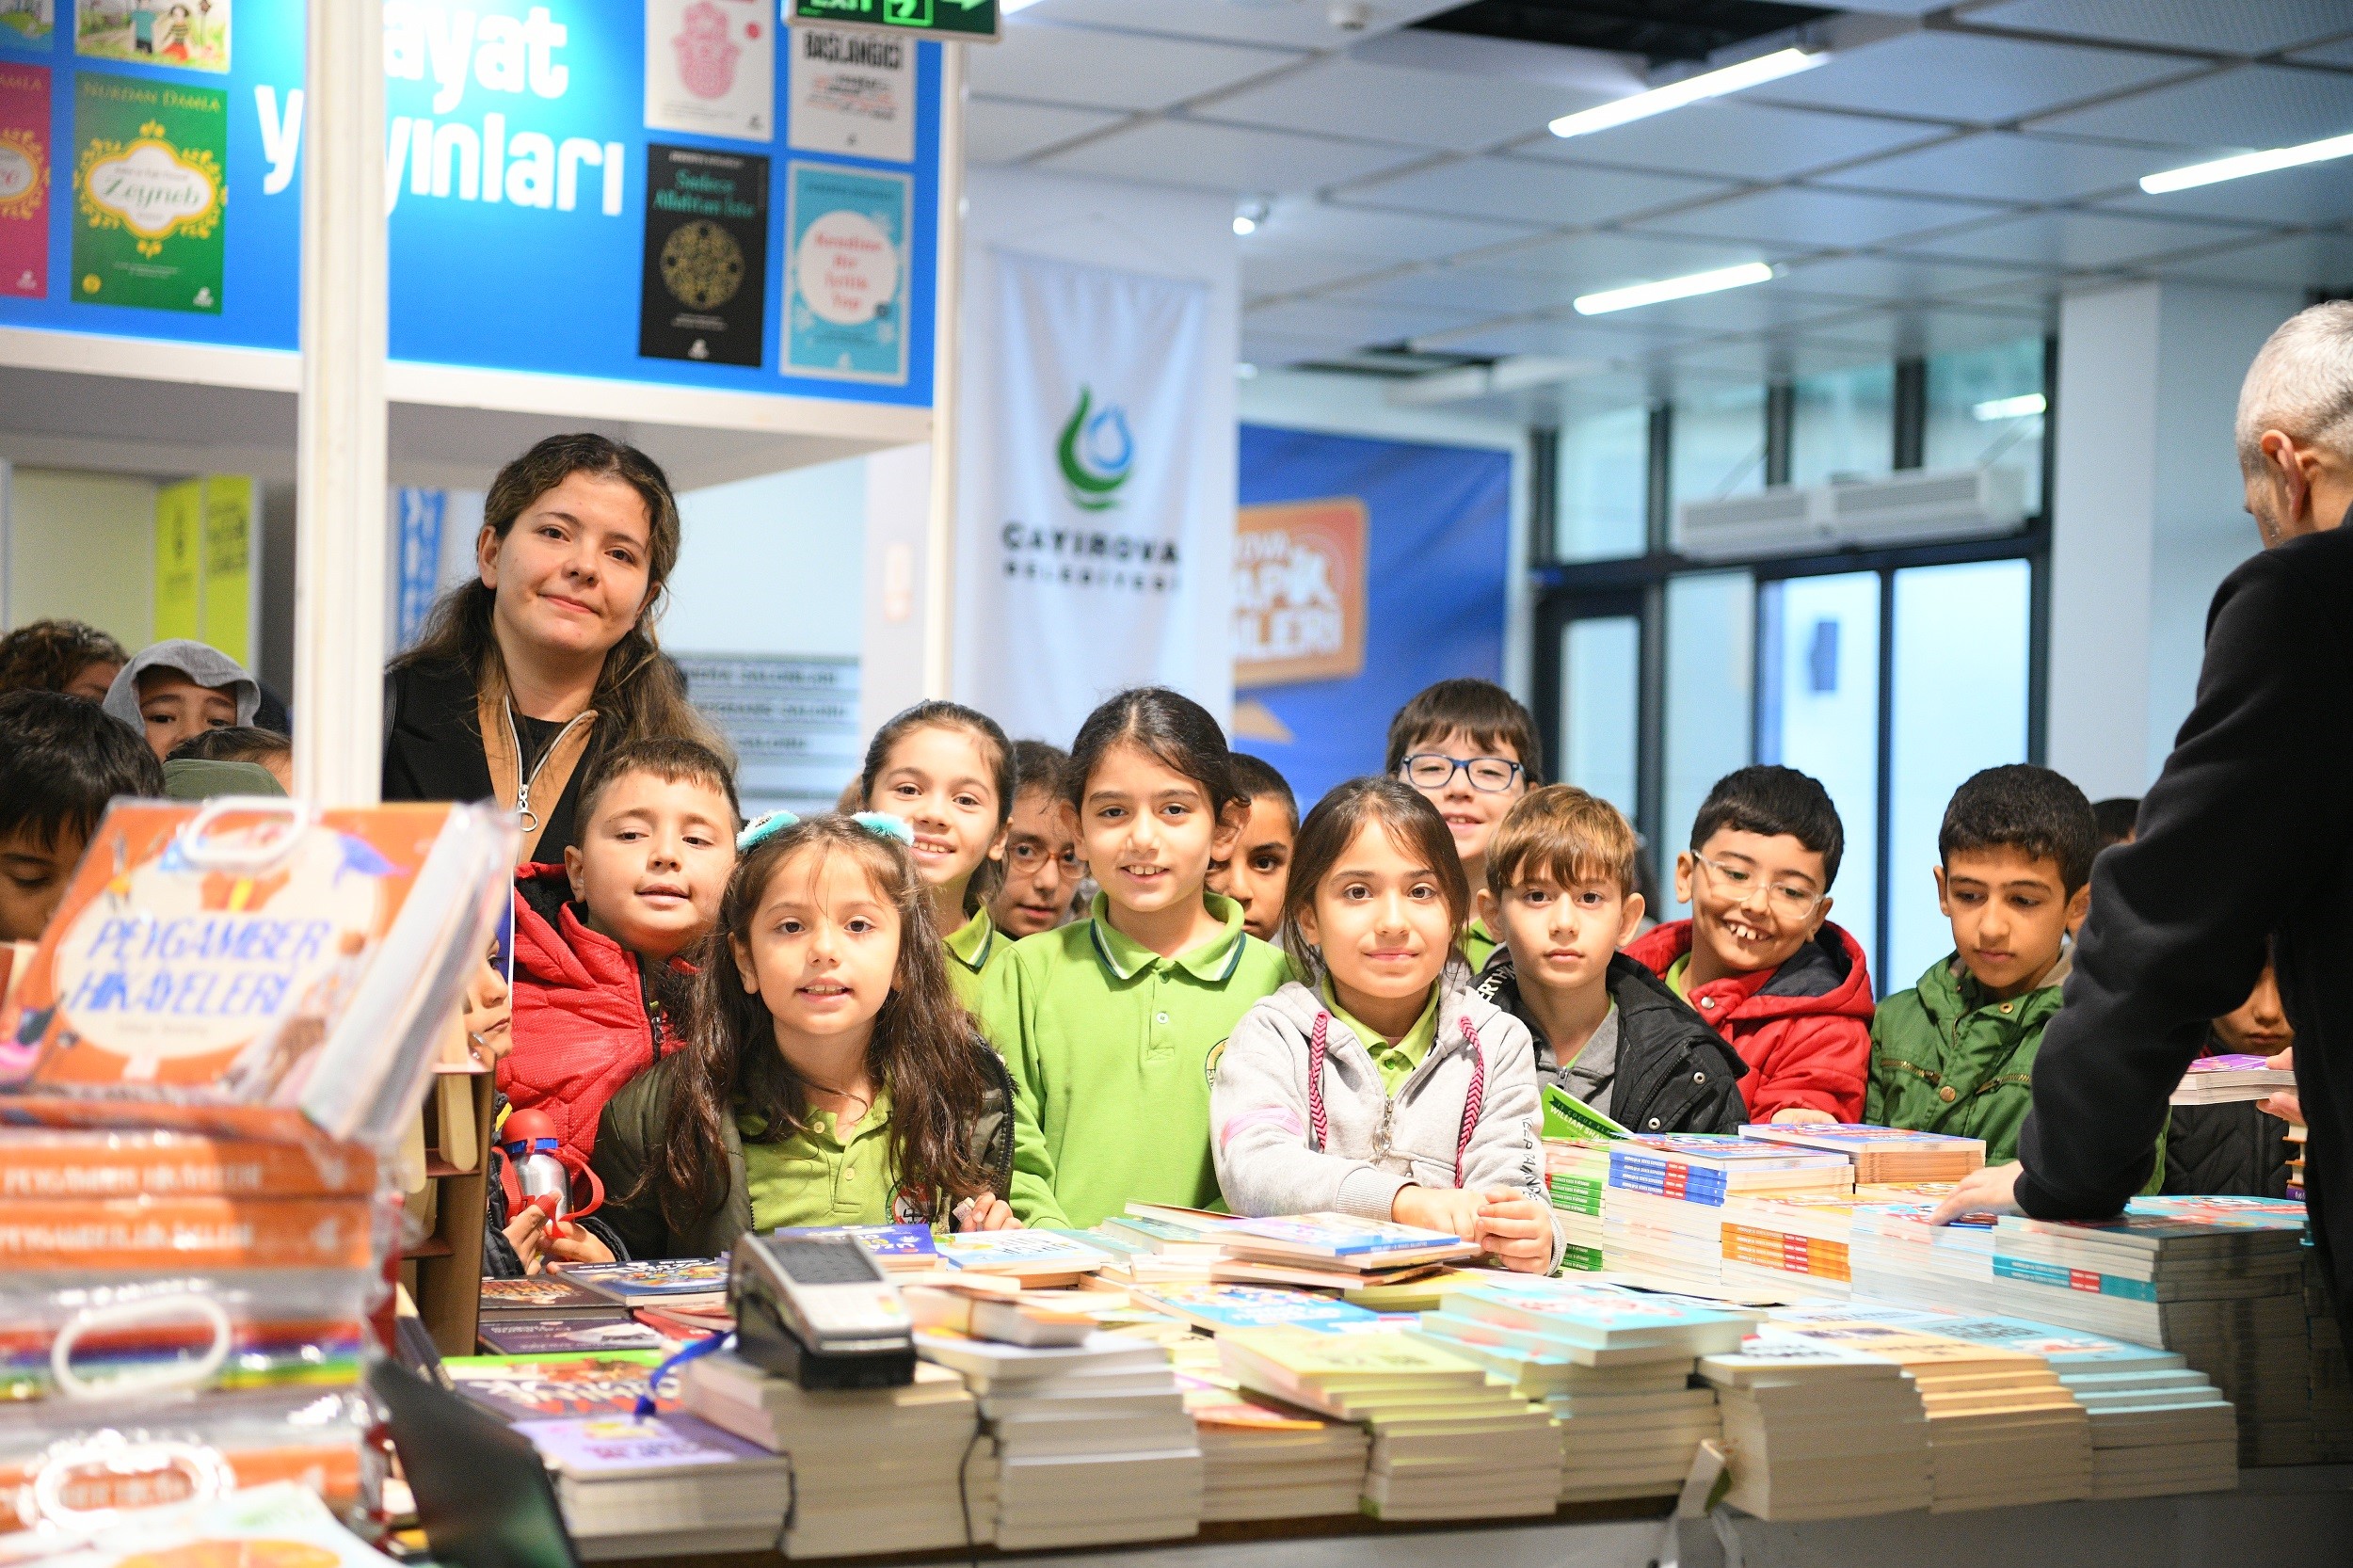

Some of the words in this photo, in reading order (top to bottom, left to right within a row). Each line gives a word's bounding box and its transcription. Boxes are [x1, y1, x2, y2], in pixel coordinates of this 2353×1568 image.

[379, 0, 569, 114] ayat
[162, 89, 221, 114] DAMLA
[254, 85, 624, 216] yyınları
[1549, 1104, 1584, 1131] WILLIAM
